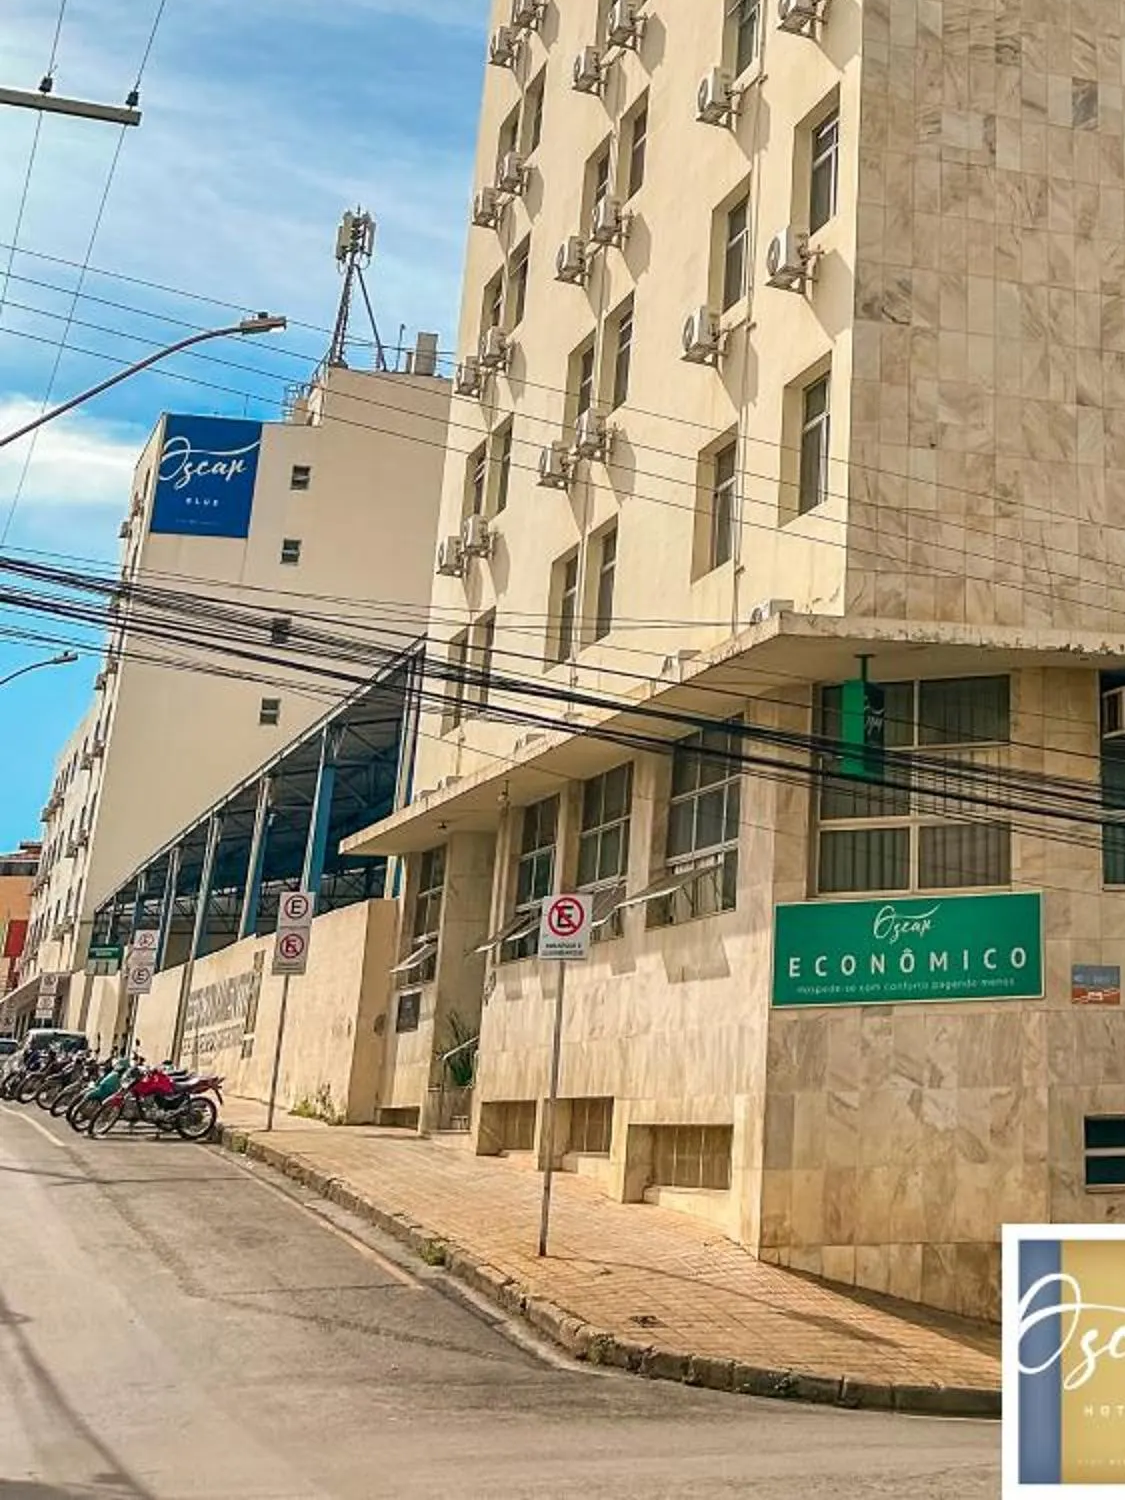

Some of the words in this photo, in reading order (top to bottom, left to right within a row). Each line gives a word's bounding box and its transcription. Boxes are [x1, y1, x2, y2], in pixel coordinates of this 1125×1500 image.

[158, 436, 261, 490] Oscar
[873, 902, 942, 945] Oscar
[788, 946, 1027, 978] ECONÔMICO
